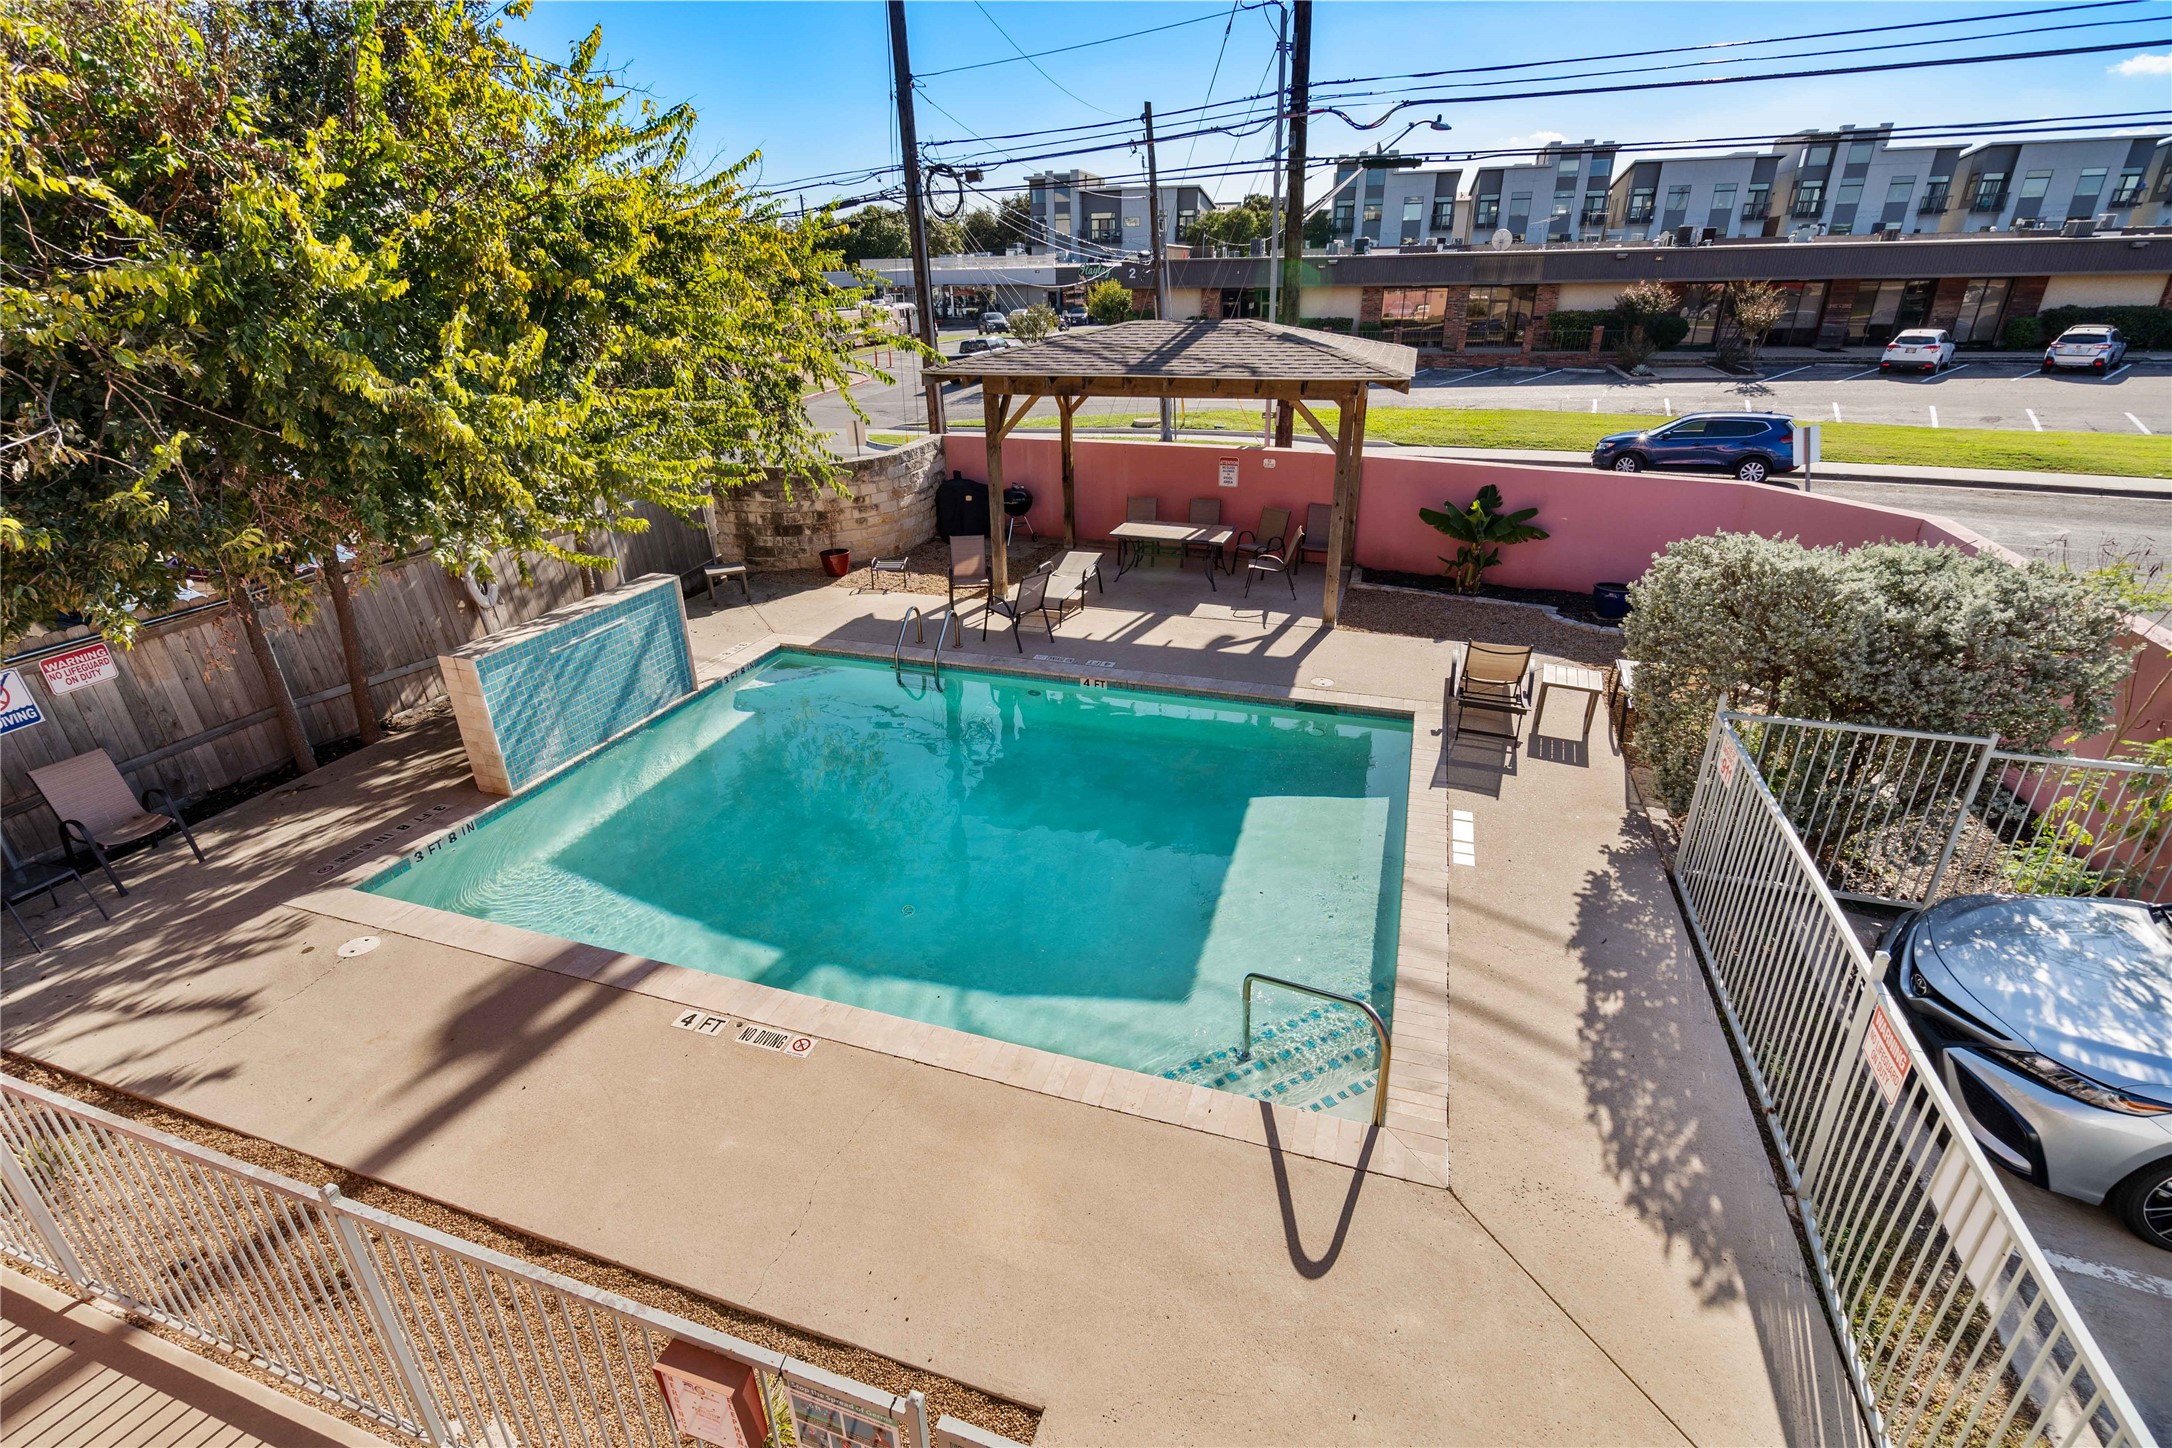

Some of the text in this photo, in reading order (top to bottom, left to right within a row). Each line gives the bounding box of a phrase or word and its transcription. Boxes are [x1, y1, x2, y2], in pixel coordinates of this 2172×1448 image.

[1129, 268, 1136, 279] 2
[44, 648, 108, 672] WARNING
[48, 657, 110, 682] NO LIFEGUARD
[65, 668, 102, 686] ON DUTY
[1083, 679, 1105, 688] 4 FT
[413, 821, 476, 863] 3 FT 8 IN
[681, 1013, 726, 1033] 4 FT
[738, 1026, 788, 1049] NO DIVING
[1875, 1010, 1907, 1071] WARNING
[1869, 1030, 1900, 1087] NO LIFEGUARD
[1870, 1049, 1890, 1085] ON DUTY
[667, 1375, 687, 1429] MERGENCY
[791, 1382, 893, 1424] Stop the Spread of Germs
[726, 1397, 745, 1448] ELEPHON
